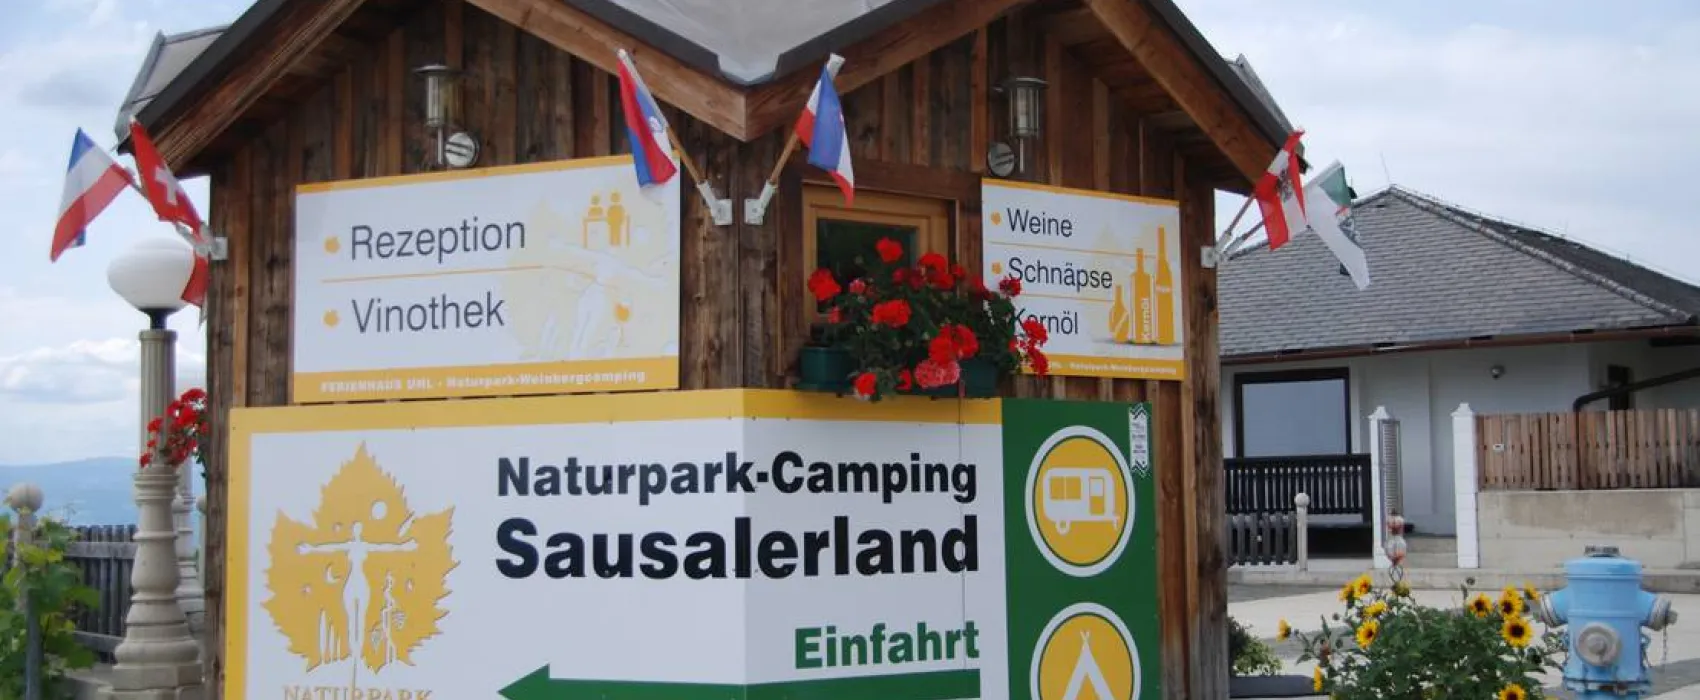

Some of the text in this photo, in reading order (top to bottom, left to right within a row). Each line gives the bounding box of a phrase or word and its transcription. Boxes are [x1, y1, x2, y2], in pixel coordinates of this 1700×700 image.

[351, 216, 526, 263] Rezeption
[1007, 208, 1073, 237] Weine
[1008, 257, 1113, 292] Schnäpse
[351, 291, 505, 334] Vinothek
[497, 451, 978, 506] Naturpark-Camping
[495, 515, 979, 579] Sausalerland
[794, 621, 980, 669] Einfahrt
